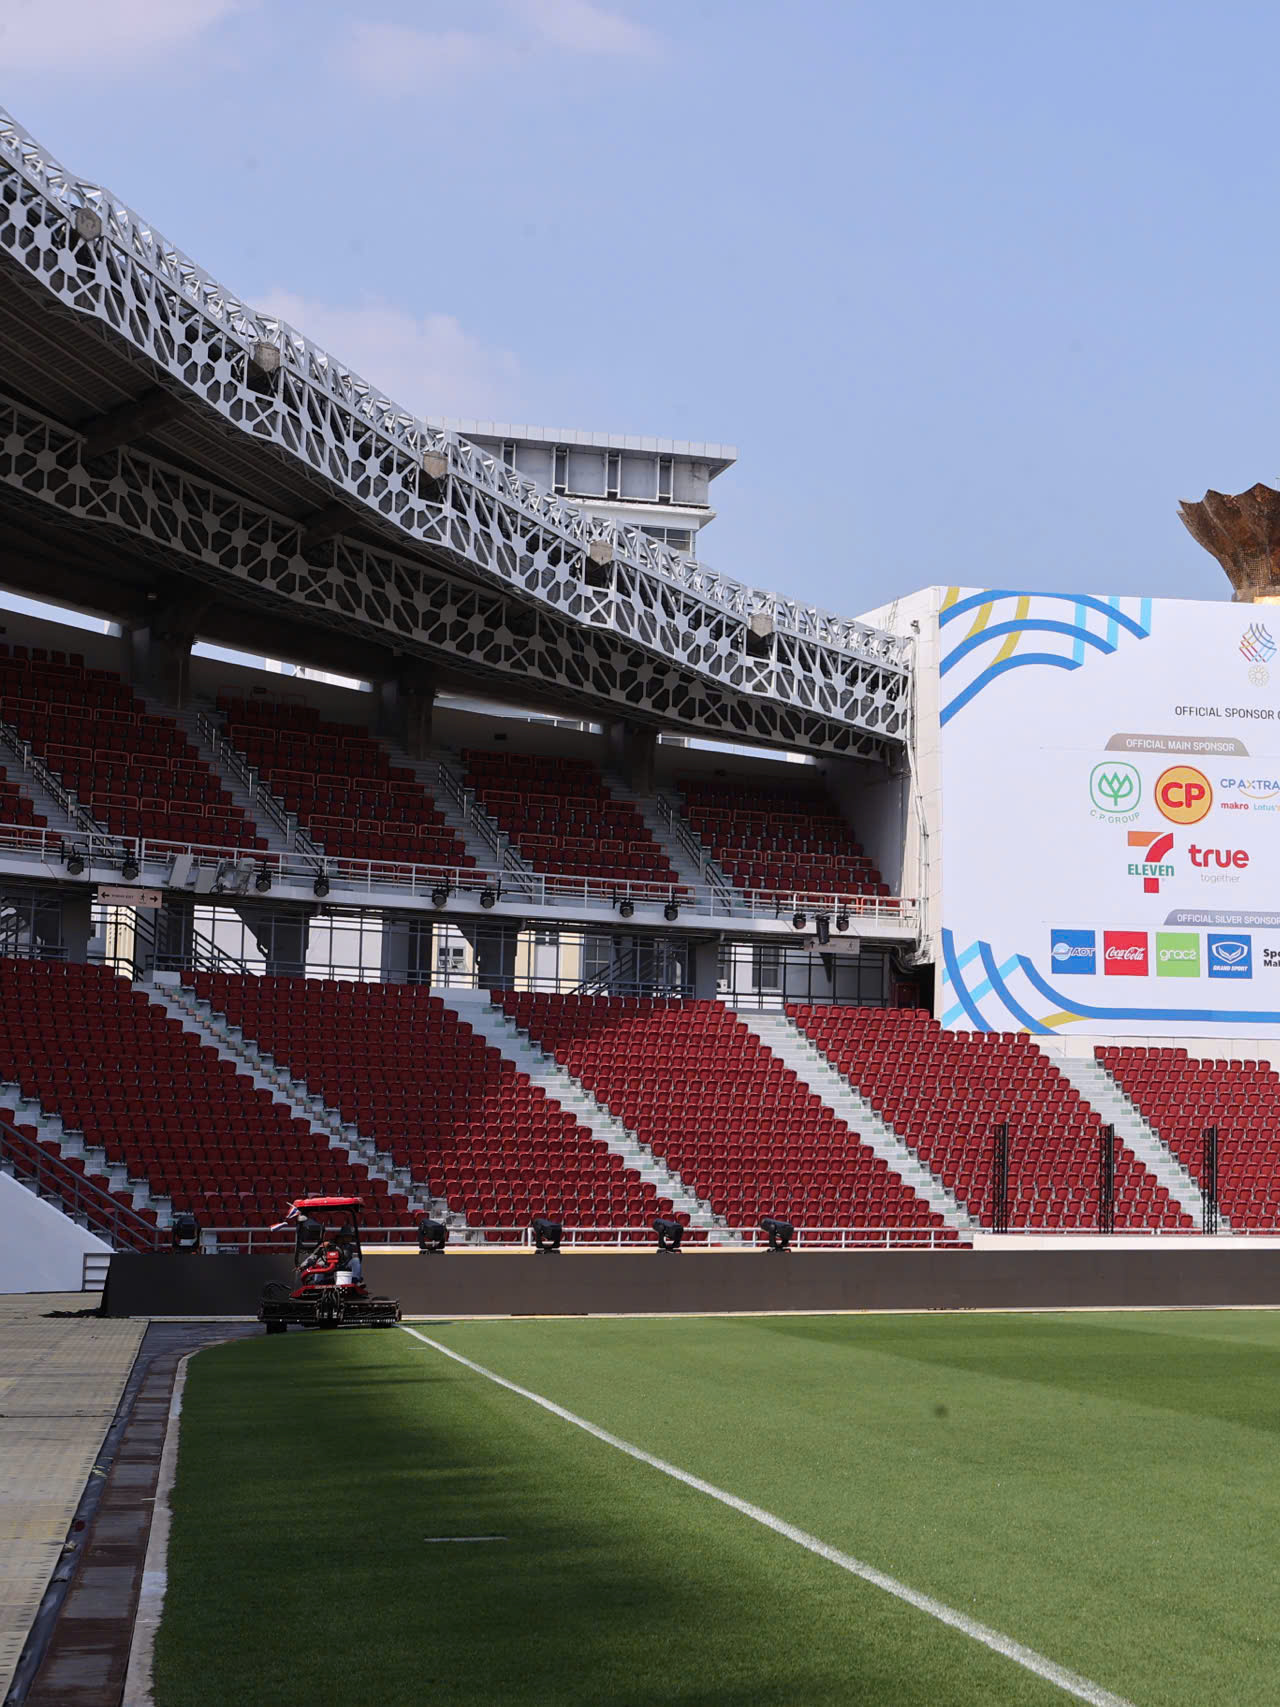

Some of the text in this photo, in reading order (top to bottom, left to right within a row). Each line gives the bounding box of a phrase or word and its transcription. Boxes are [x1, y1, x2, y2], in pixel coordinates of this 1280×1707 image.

[1174, 705, 1222, 718] OFFICIAL
[1224, 707, 1275, 720] SPONSOR
[1126, 738, 1235, 752] OFFICIAL MAIN SPONSOR
[1220, 778, 1236, 789] CP
[1161, 781, 1206, 809] CP
[1220, 802, 1249, 811] makro
[1188, 844, 1250, 869] true
[1200, 873, 1241, 884] together
[1177, 913, 1213, 923] OFFICIAL
[1215, 914, 1242, 924] SILVER
[1071, 947, 1096, 957] AOT
